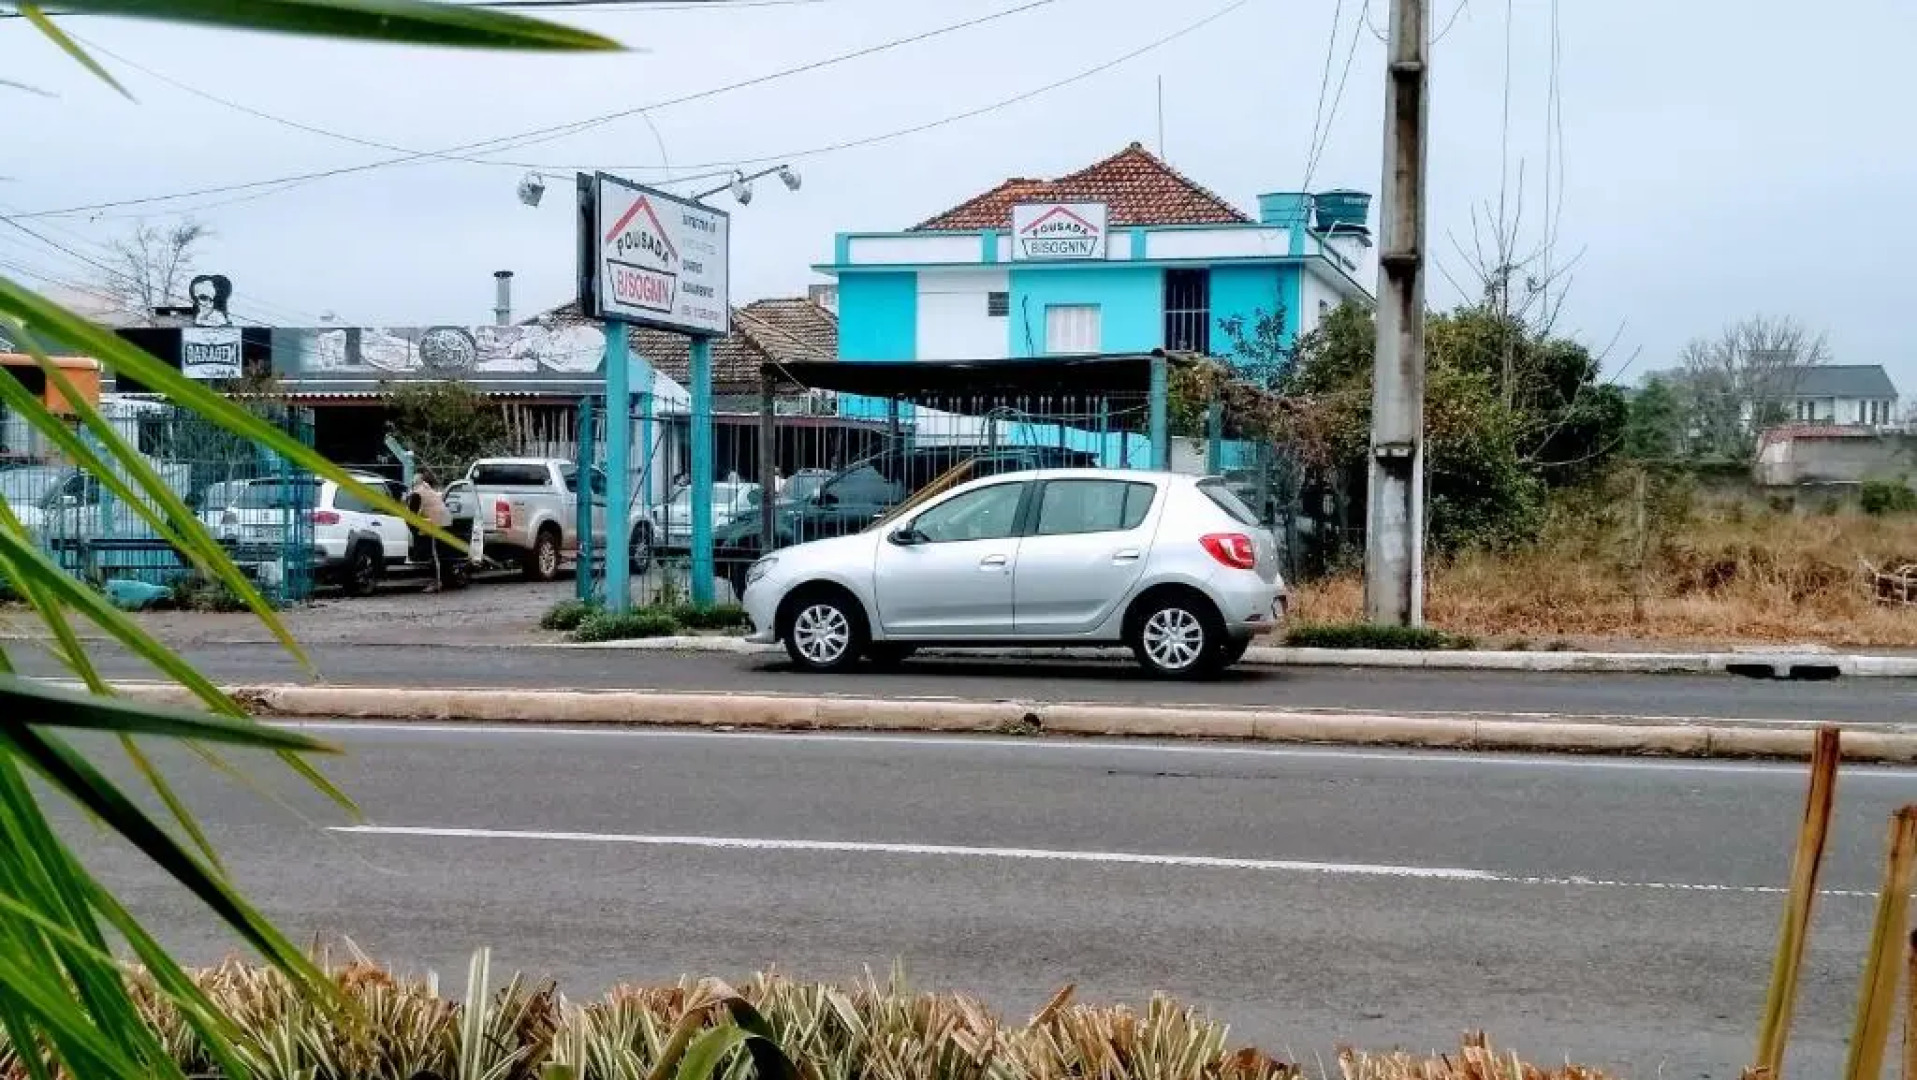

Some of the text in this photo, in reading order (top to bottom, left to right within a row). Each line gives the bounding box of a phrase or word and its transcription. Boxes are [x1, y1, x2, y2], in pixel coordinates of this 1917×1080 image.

[1032, 222, 1088, 237] POUSADA
[617, 231, 669, 263] POUSADA
[1031, 241, 1088, 254] BISOGNIN
[617, 269, 670, 304] BISOGNIN
[186, 344, 238, 365] GARAGEM
